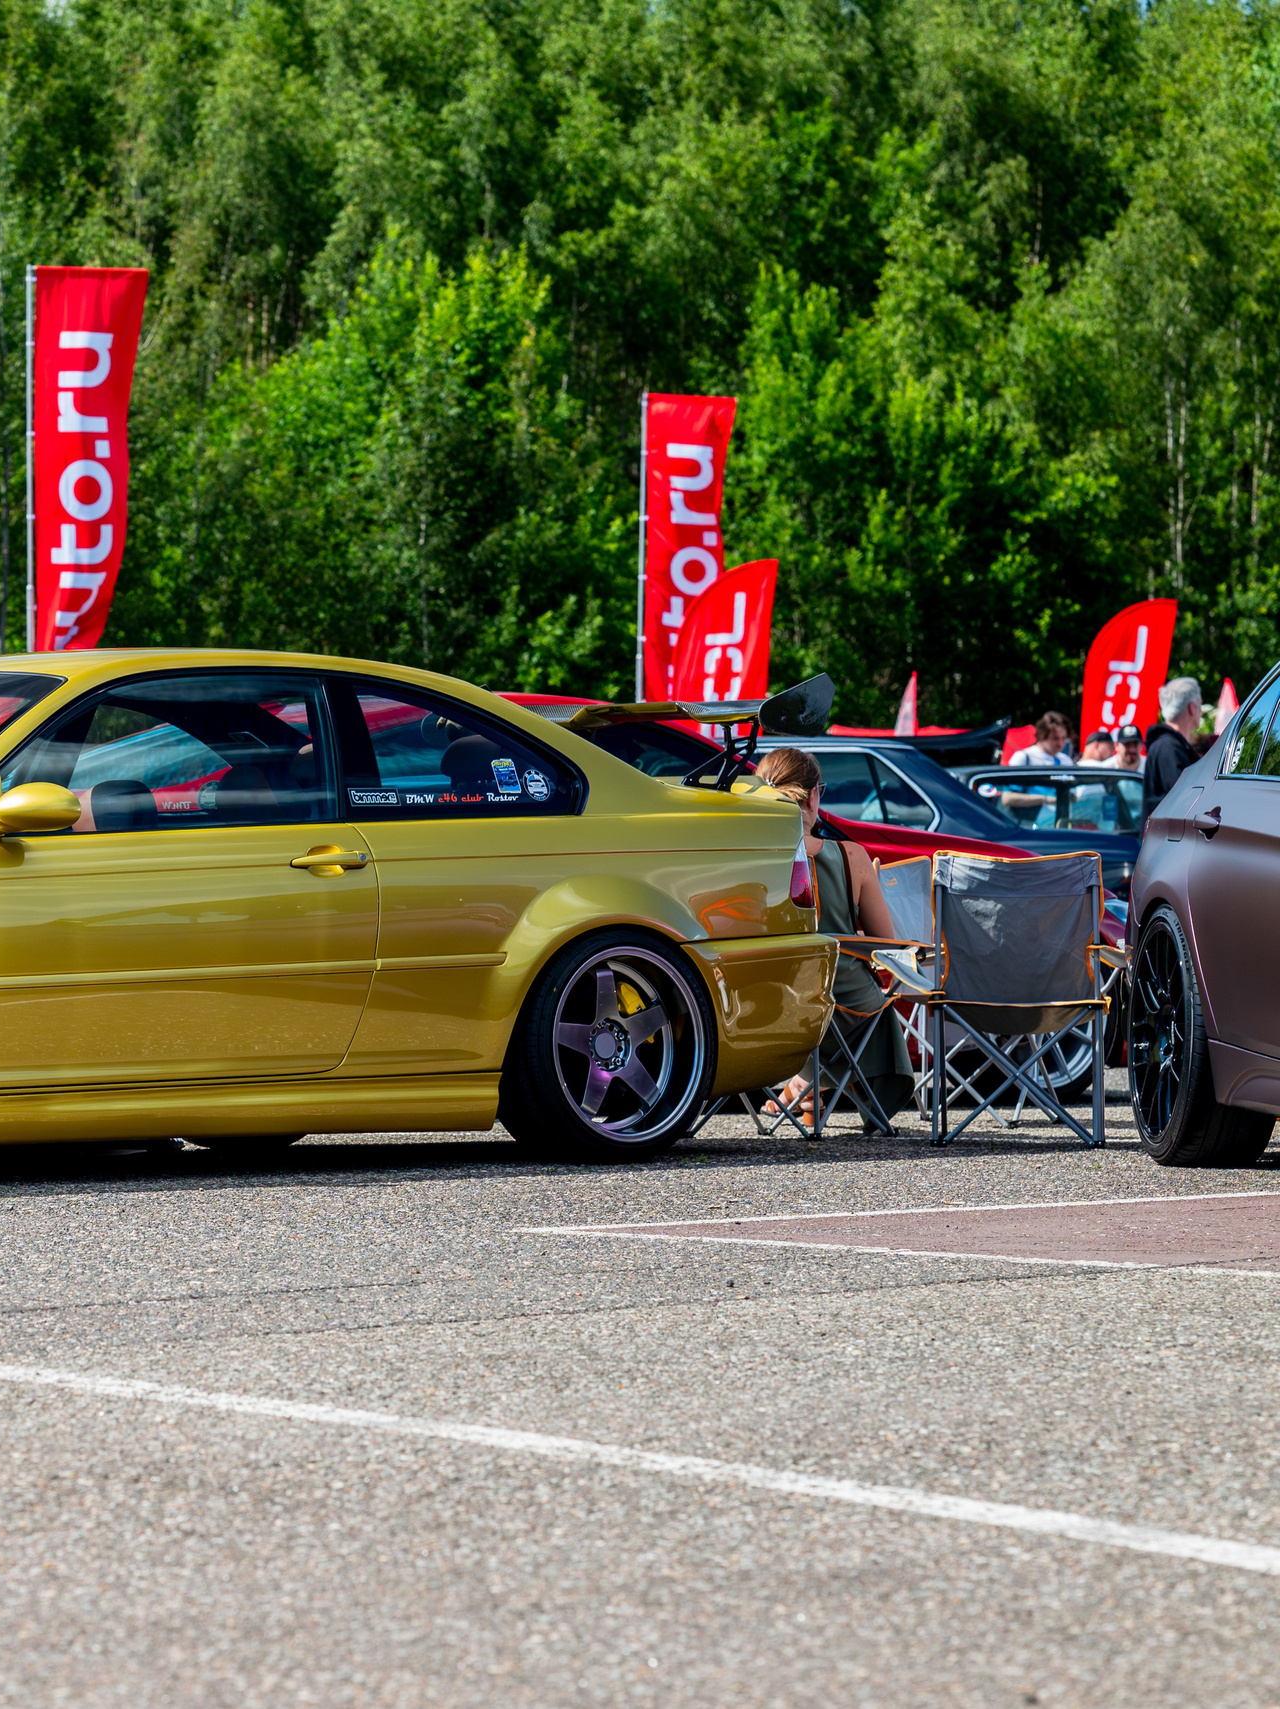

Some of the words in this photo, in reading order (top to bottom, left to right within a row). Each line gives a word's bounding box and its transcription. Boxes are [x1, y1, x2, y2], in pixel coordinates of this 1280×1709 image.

[661, 443, 718, 701] o.ru
[406, 794, 434, 803] BMW
[437, 793, 458, 803] e46
[461, 793, 484, 803] club
[486, 792, 519, 801] Rostov
